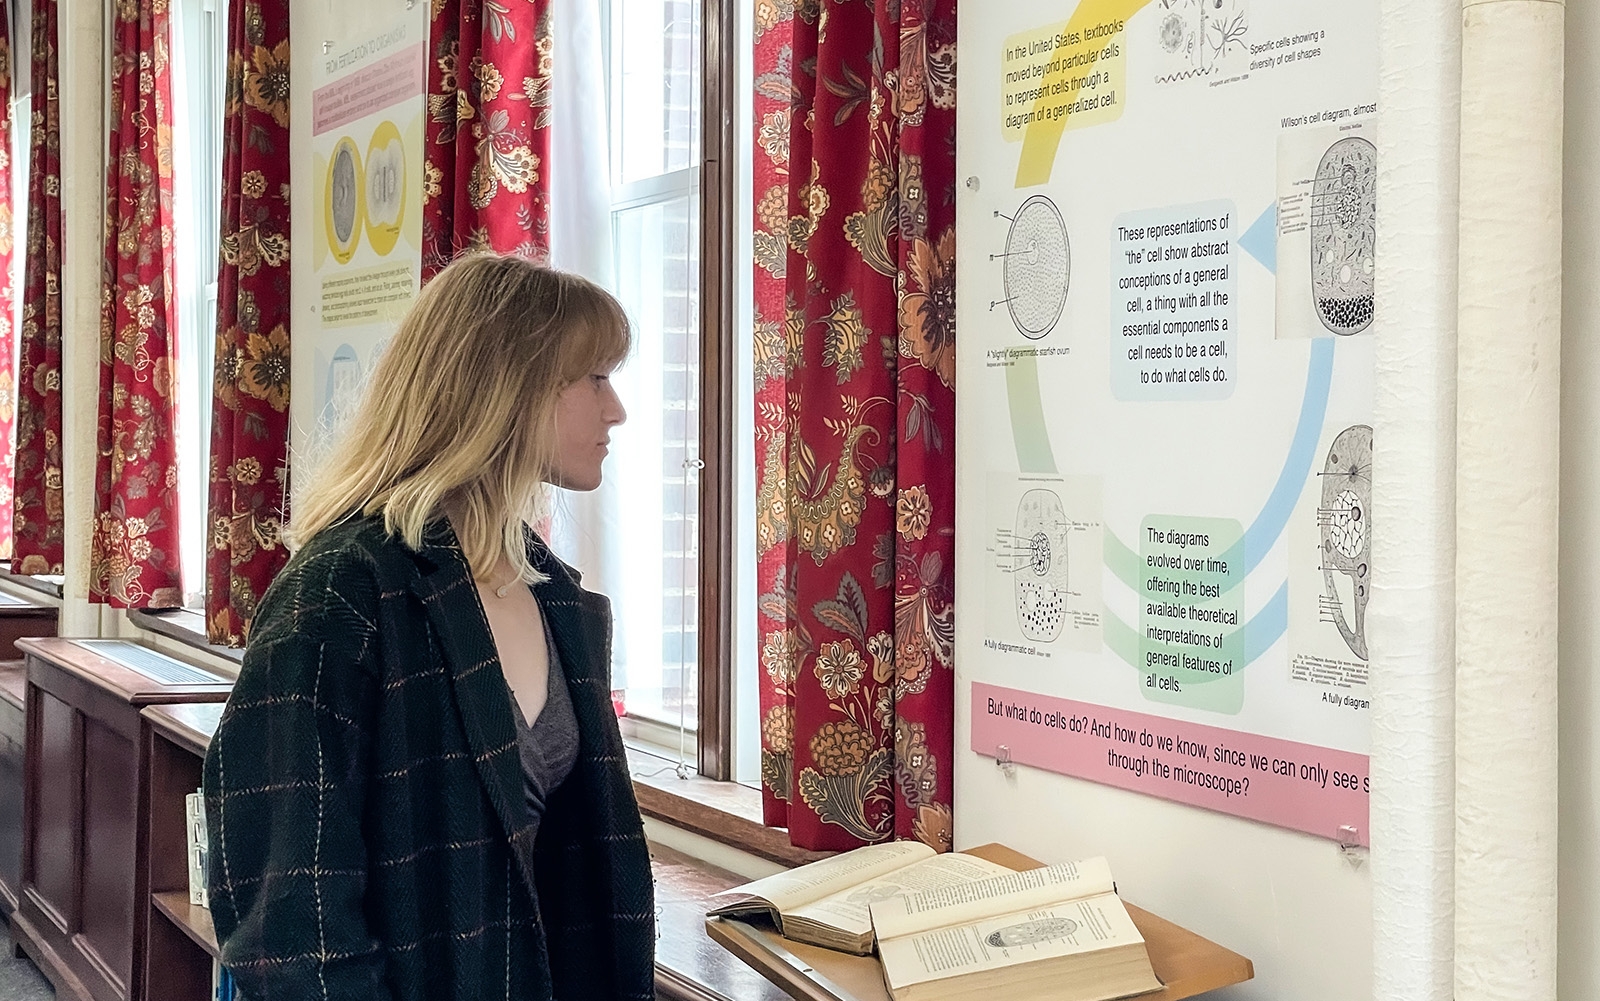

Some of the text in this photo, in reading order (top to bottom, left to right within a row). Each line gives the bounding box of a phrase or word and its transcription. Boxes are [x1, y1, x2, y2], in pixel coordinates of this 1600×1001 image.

[1006, 19, 1123, 62] In the United States, textbooks
[1250, 30, 1325, 56] Specific cells showing a
[1006, 43, 1119, 83] moved beyond particular cells
[1250, 48, 1321, 71] diversity of cell shapes
[1006, 72, 1109, 106] to represent cells through a
[1006, 90, 1117, 129] diagram of a generalized cell.
[1281, 102, 1377, 128] Wilson's cell diagram, almost
[1118, 213, 1229, 241] These representations of
[1125, 240, 1229, 264] “the” cell show abstract
[1119, 264, 1228, 290] conceptions of a general
[1127, 290, 1228, 313] cell, a thing with all the
[1123, 317, 1228, 337] essential components a
[1128, 340, 1227, 360] cell needs to be a cell,
[1141, 366, 1227, 384] to do what cells do.
[1147, 527, 1209, 549] The diagrams
[1147, 553, 1230, 576] evolved over time,
[1147, 576, 1220, 598] offering the best
[1147, 601, 1237, 625] available theoretical
[1147, 624, 1223, 649] interpretations of
[1027, 647, 1036, 655] cell
[1146, 652, 1232, 675] general features of
[1146, 673, 1182, 692] all cells.
[1322, 692, 1327, 702] A
[1328, 693, 1342, 707] fully
[988, 697, 1003, 716] But
[1005, 703, 1027, 722] what
[1030, 707, 1042, 725] do
[1044, 711, 1066, 730] cells
[1069, 714, 1088, 734] do?
[1090, 718, 1111, 739] And
[1115, 723, 1136, 744] how
[1139, 728, 1153, 748] do
[1157, 736, 1173, 752] we
[1177, 735, 1209, 763] know,
[1214, 747, 1246, 767] since
[1250, 754, 1268, 771] we
[1272, 759, 1296, 777] can
[1300, 763, 1328, 789] only
[1333, 771, 1358, 790] see
[1108, 749, 1249, 797] through the microscope?
